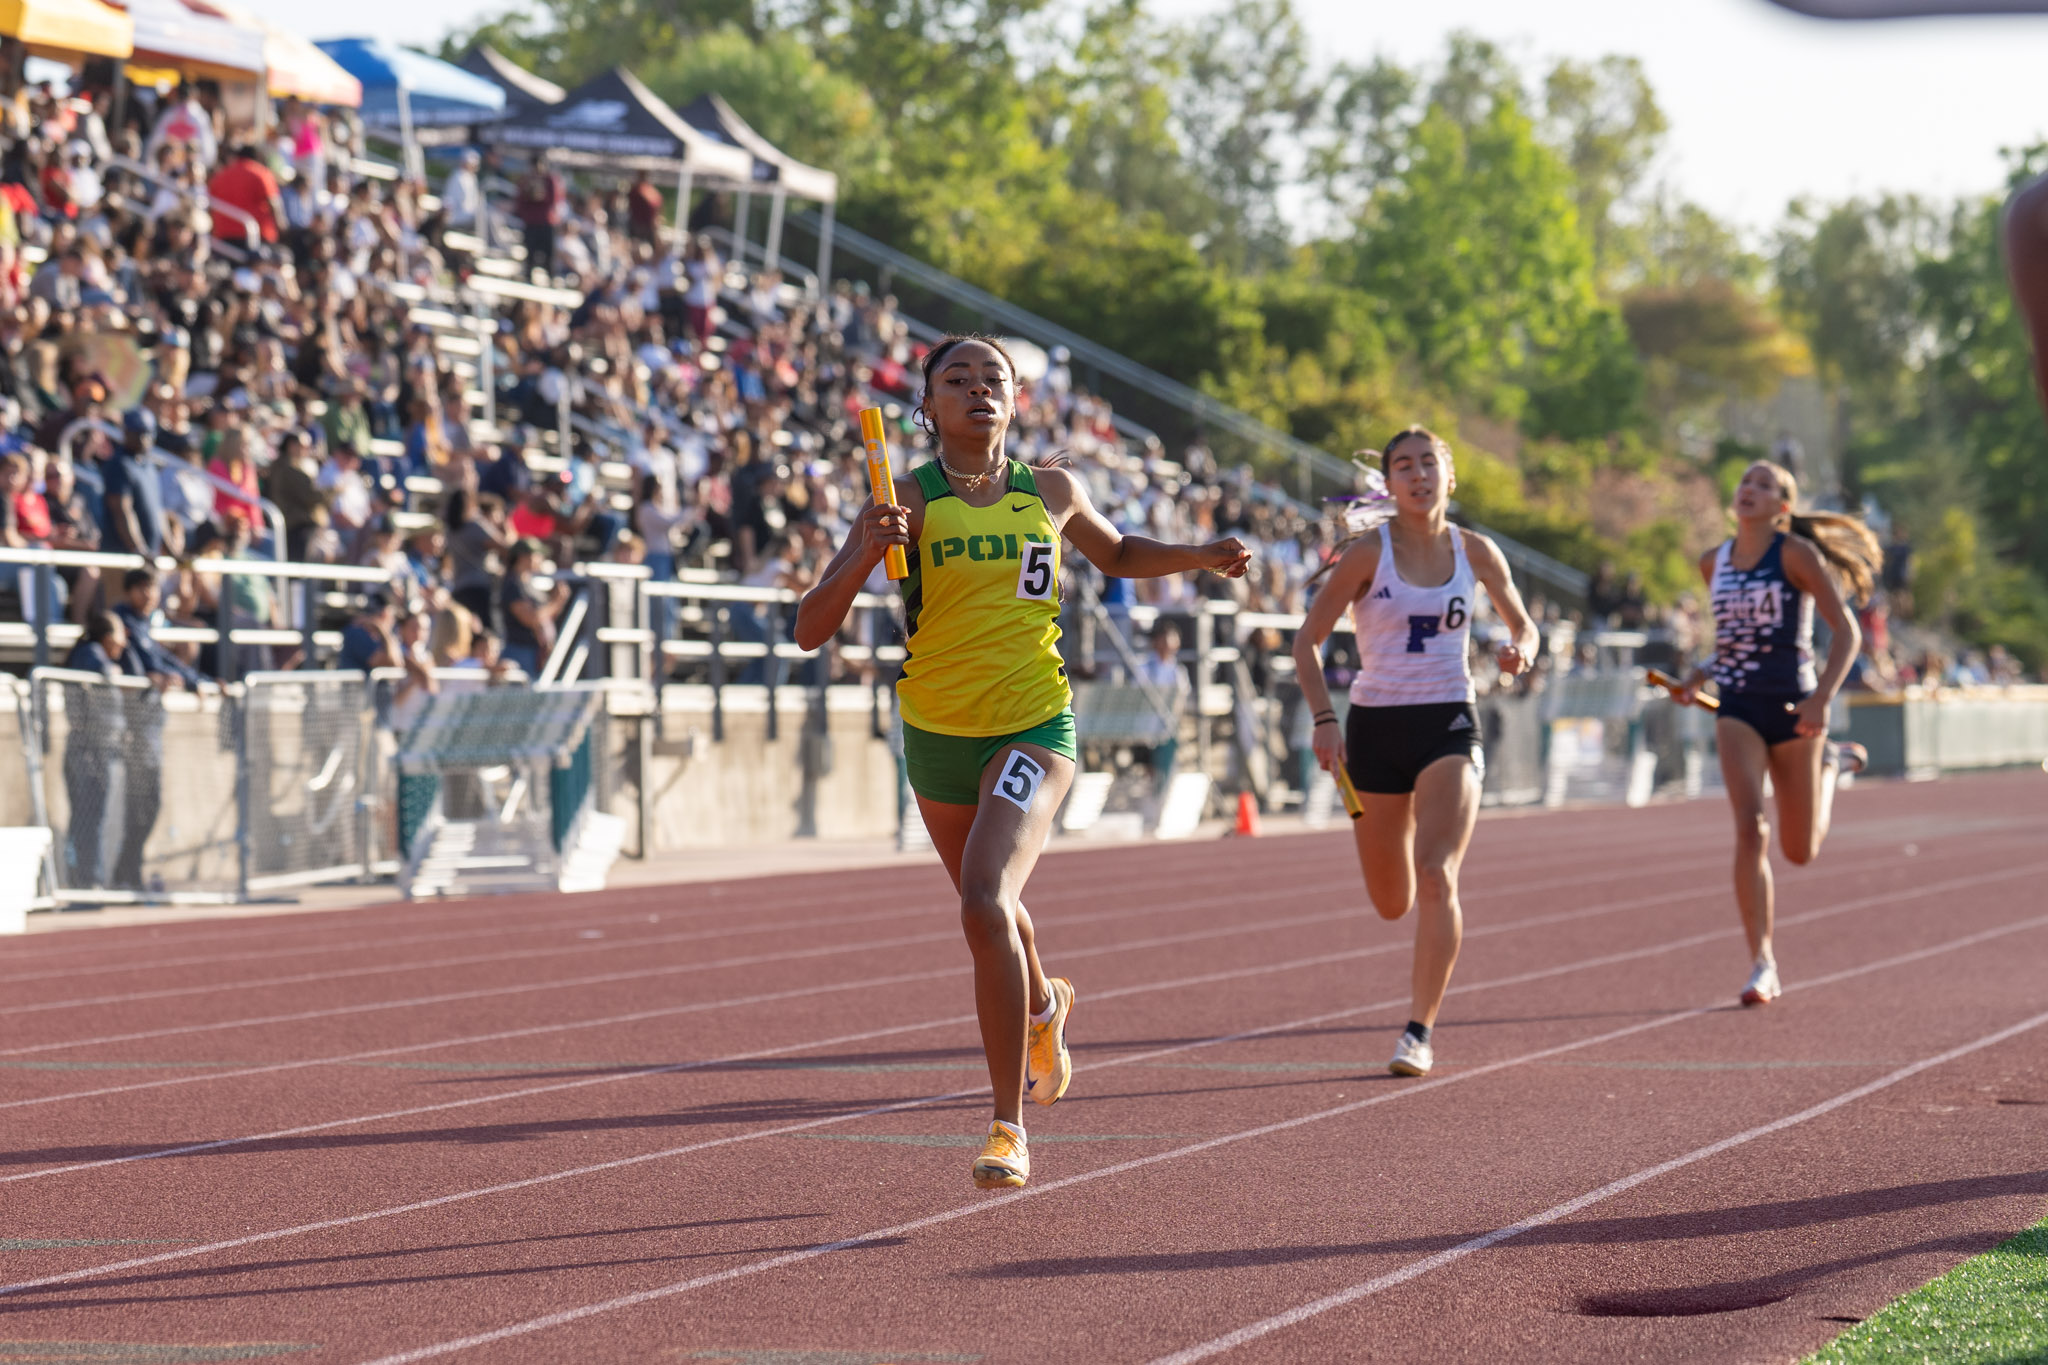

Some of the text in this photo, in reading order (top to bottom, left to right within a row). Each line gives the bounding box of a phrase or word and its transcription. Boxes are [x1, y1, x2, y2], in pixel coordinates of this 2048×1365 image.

[1024, 547, 1052, 596] 5
[1406, 615, 1441, 653] P
[1446, 596, 1466, 630] 6
[1002, 755, 1040, 802] 5
